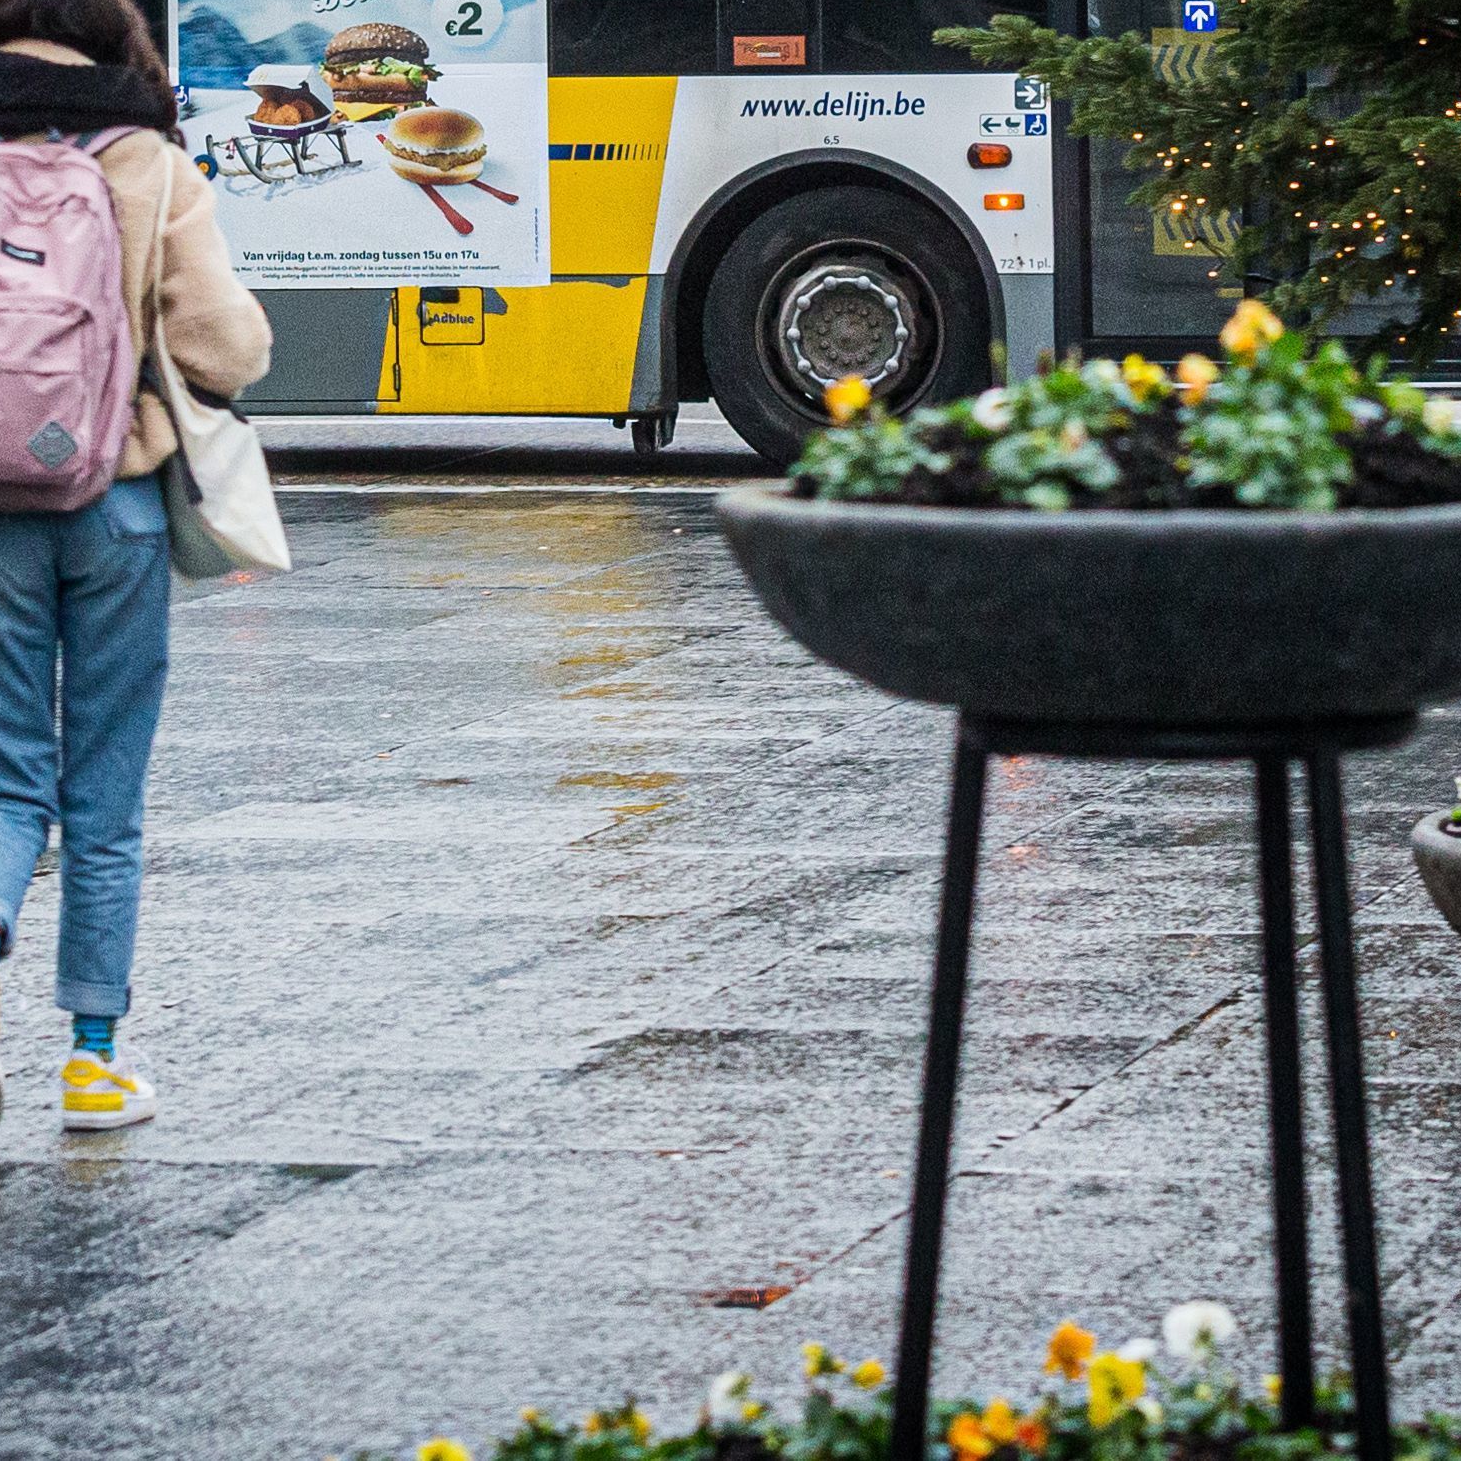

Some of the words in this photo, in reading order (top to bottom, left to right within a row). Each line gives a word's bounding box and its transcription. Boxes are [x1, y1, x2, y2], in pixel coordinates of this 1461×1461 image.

[445, 1, 483, 36] €2
[740, 91, 926, 122] www.delijn.be
[823, 135, 840, 146] 6,5
[242, 250, 264, 261] Van
[266, 250, 305, 263] vrijdag
[307, 250, 337, 260] t.e.m.
[339, 250, 380, 262] zondag
[382, 250, 420, 260] tussen
[423, 250, 442, 260] 15u
[444, 251, 458, 260] en
[461, 250, 480, 260] 17u
[999, 258, 1015, 270] 72
[1037, 257, 1052, 271] pl.
[433, 312, 475, 324] Adblue
